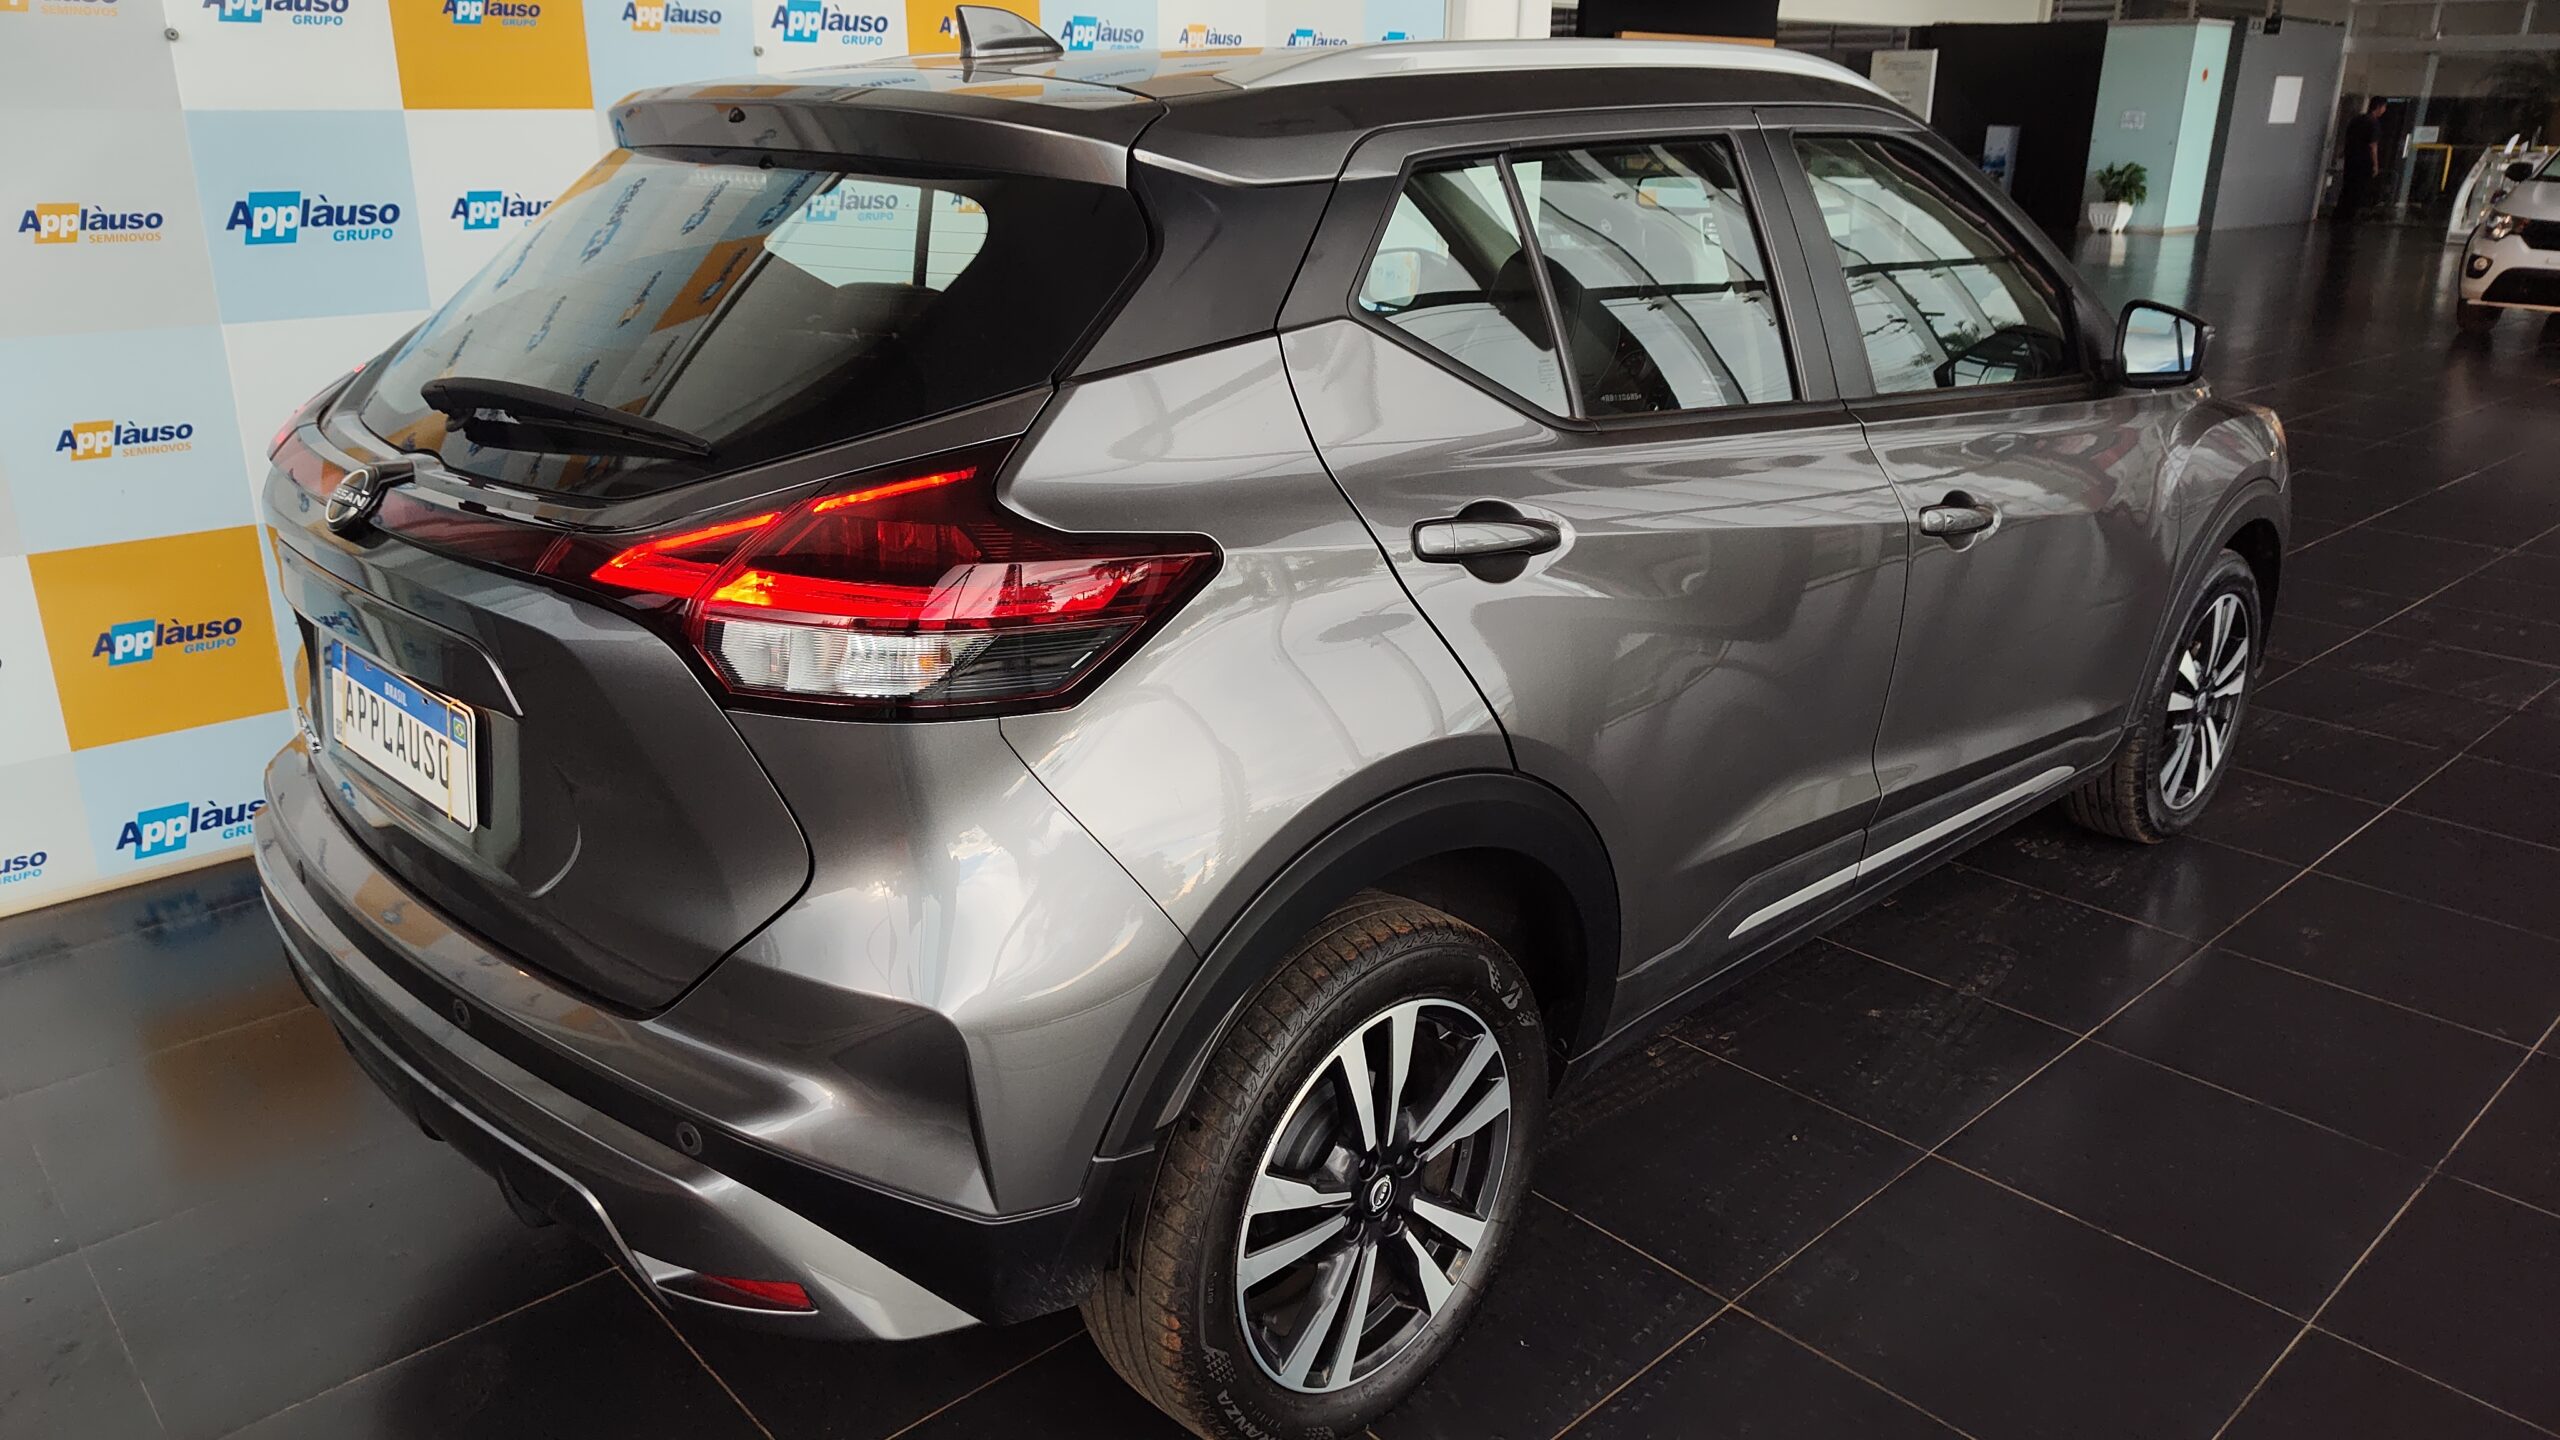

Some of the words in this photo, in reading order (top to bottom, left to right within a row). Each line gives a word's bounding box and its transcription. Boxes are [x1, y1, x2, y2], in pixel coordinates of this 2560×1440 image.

[292, 14, 344, 26] GRUPO
[622, 1, 722, 27] Applàuso
[771, 5, 888, 37] Applàuso
[842, 34, 883, 46] GRUPO
[1061, 20, 1144, 47] Applàuso
[18, 205, 163, 238] Applàuso
[226, 195, 400, 238] Applàuso
[89, 232, 162, 244] SEMINOVOS
[333, 228, 393, 241] GRUPO
[56, 421, 193, 455] Applàuso
[122, 442, 192, 457] SEMINOVOS
[92, 617, 242, 660] Applàuso
[184, 637, 236, 653] GRUPO
[384, 681, 407, 706] BRASIL
[346, 681, 451, 790] APPLAUSO
[0, 868, 42, 885] RUPO
